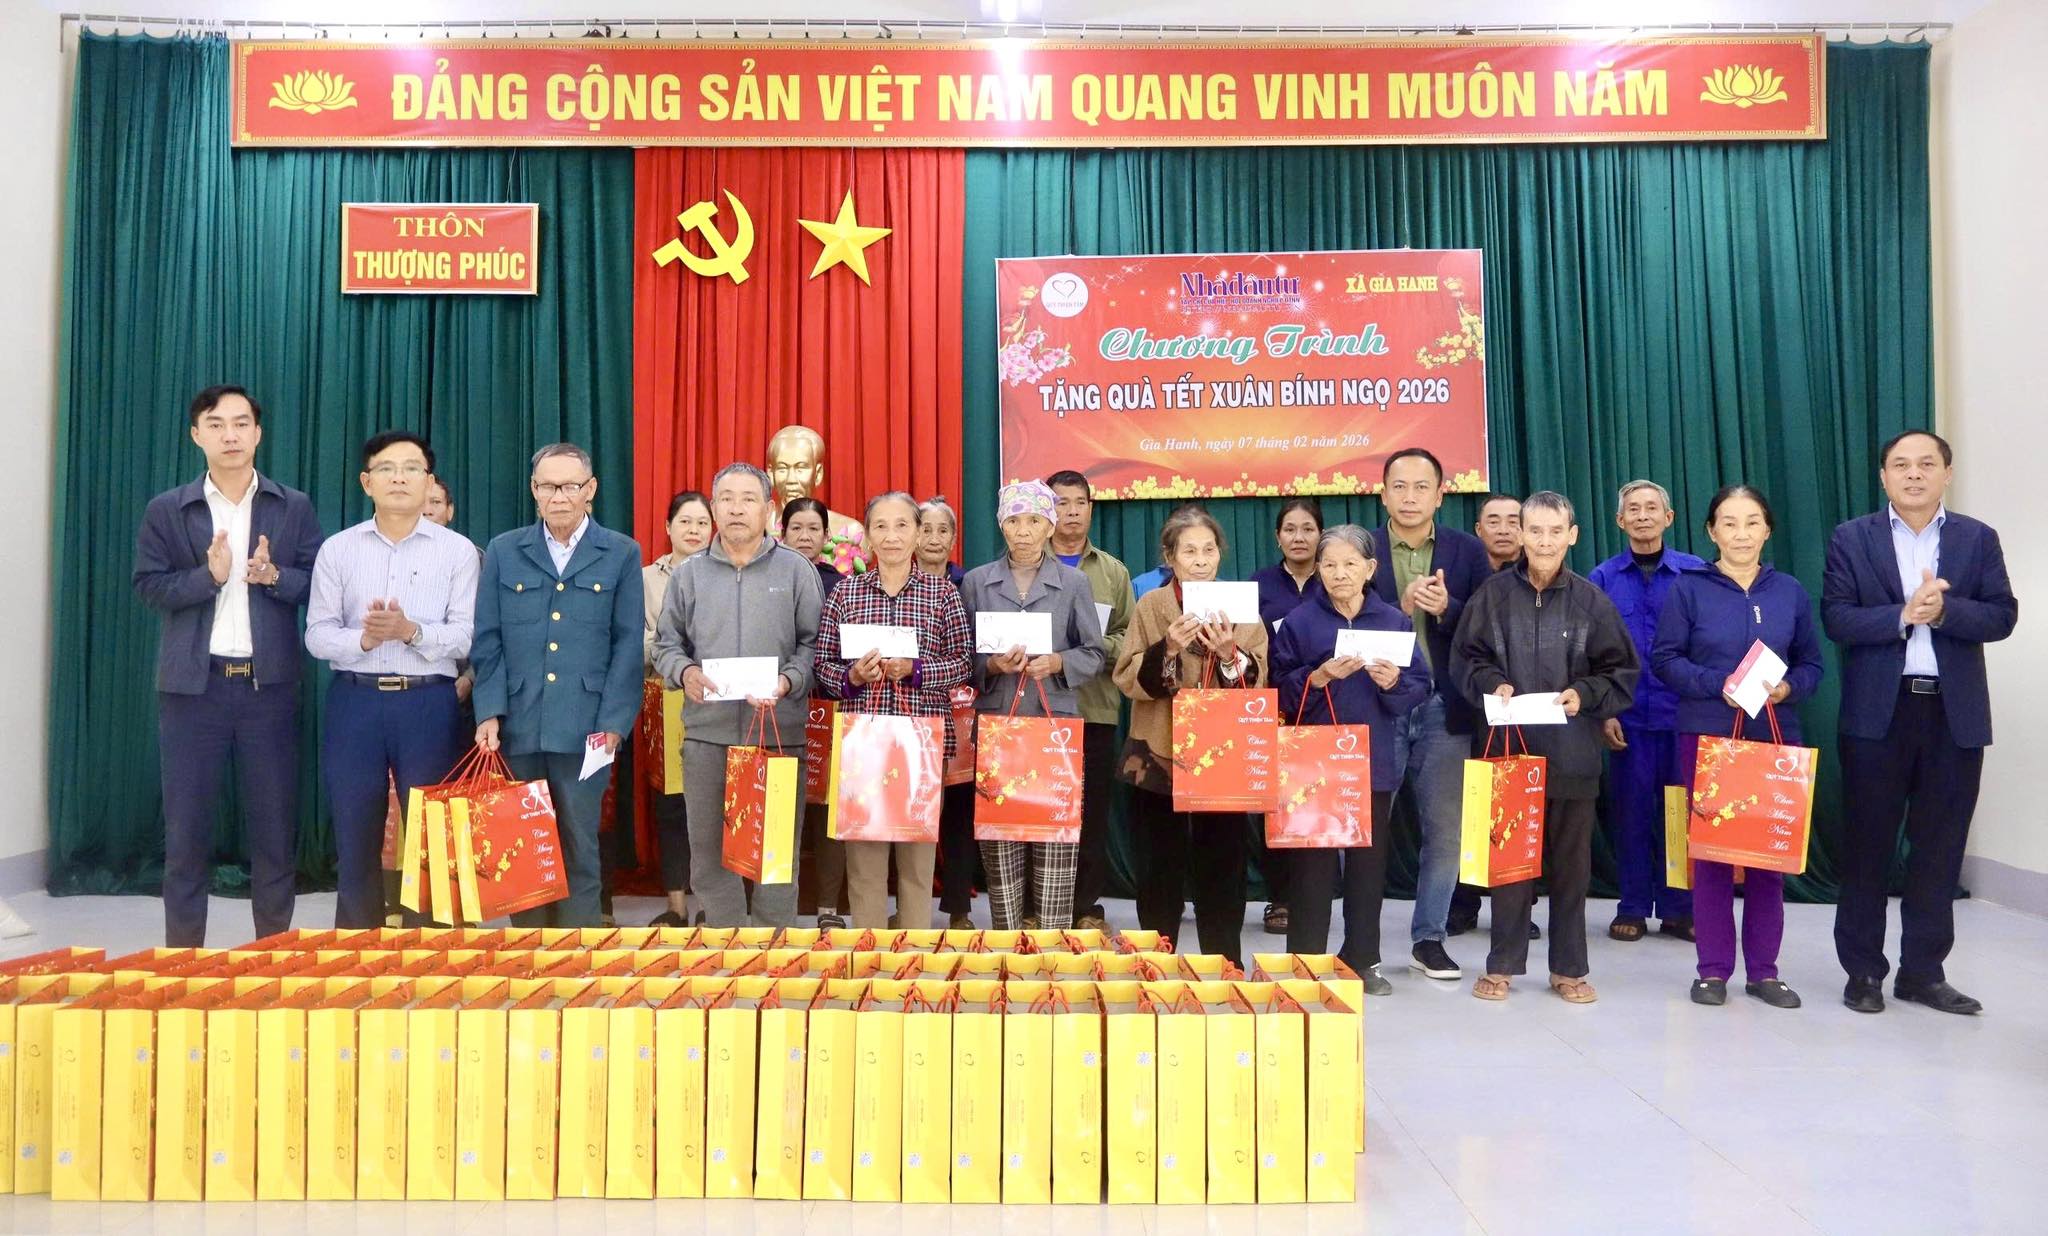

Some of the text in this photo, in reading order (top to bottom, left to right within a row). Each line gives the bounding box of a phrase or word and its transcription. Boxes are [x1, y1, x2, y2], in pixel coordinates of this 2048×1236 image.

[391, 58, 1668, 132] ĐẢNG CỘNG SẢN VIỆT NAM QUANG VINH MUÔN NĂM
[393, 211, 486, 238] THÔN
[353, 246, 526, 286] THƯỢNG PHÚC
[1369, 277, 1395, 293] GIA
[1396, 276, 1439, 292] HANH
[1100, 322, 1389, 365] Chương Trình
[1038, 372, 1450, 418] TẶNG QUÀ TẾT XUÂN BÍNH NGỌ 2026
[1140, 433, 1371, 453] Gia Hanh, ngày 07 tháng 02 năm 2026
